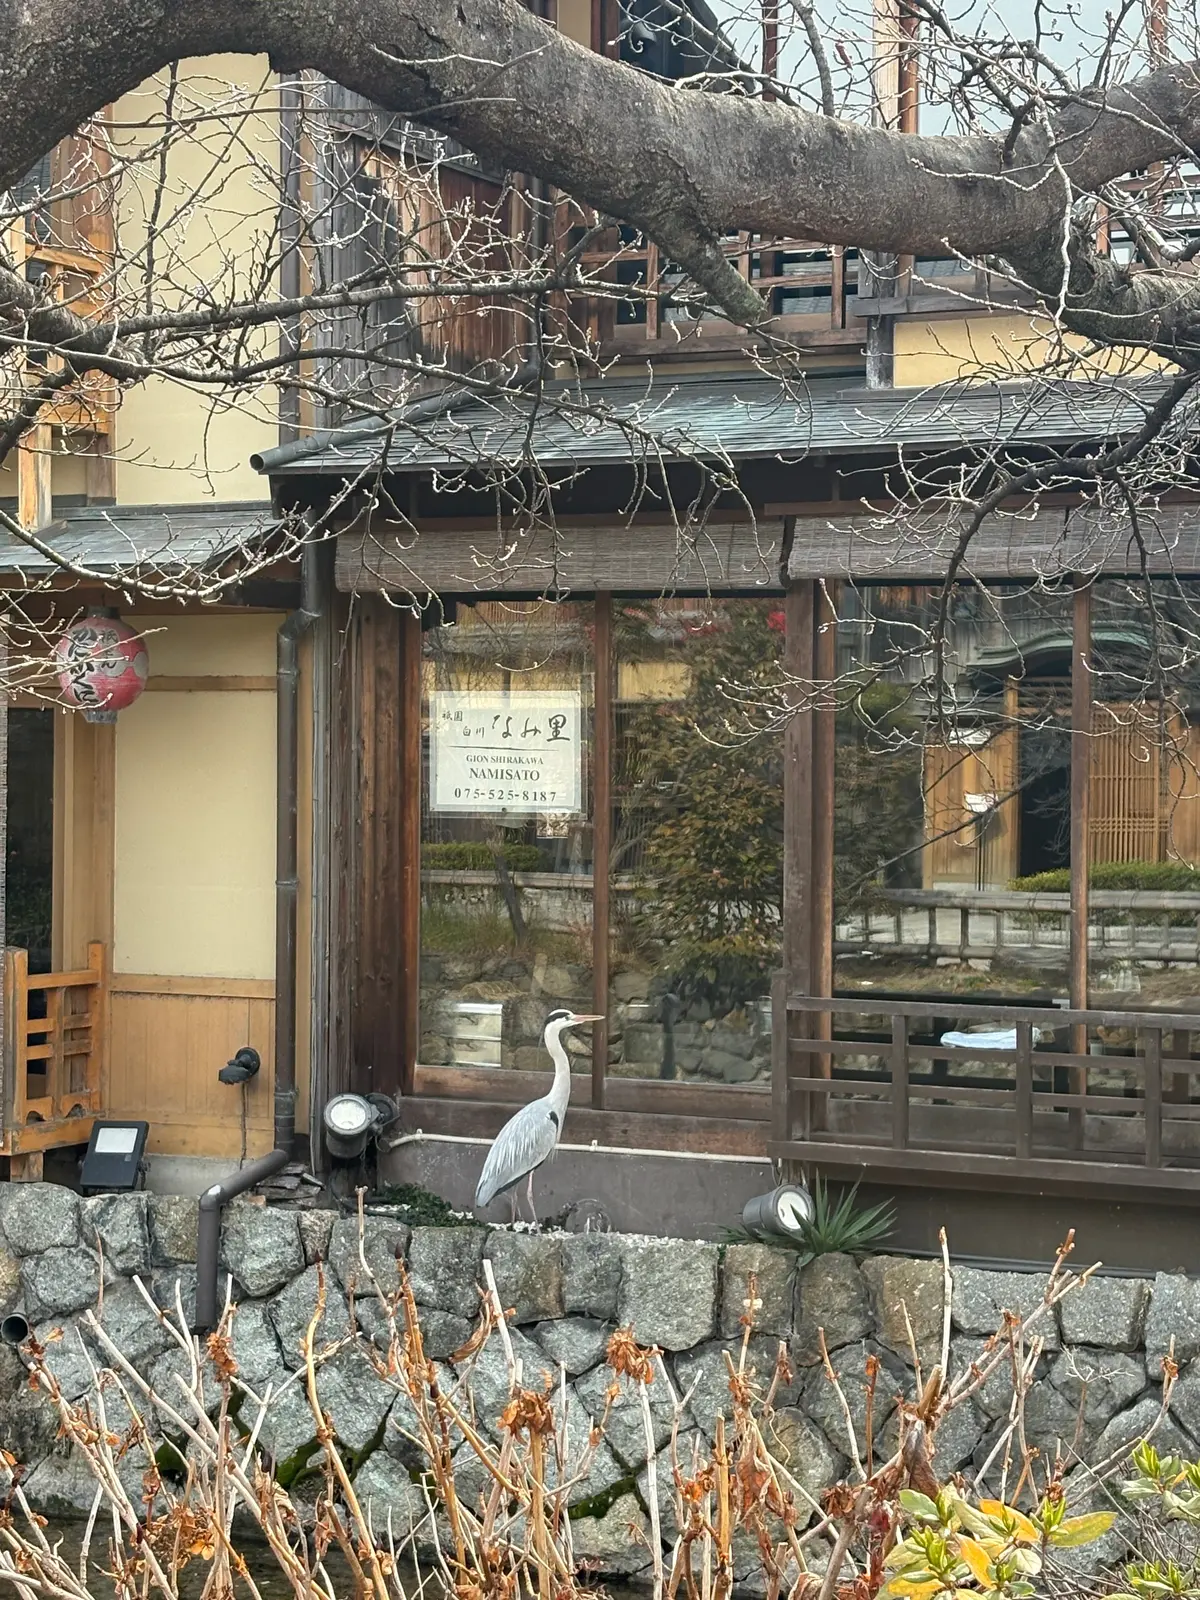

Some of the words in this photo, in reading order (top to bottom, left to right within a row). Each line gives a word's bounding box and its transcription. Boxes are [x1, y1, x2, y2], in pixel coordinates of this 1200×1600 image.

[463, 726, 485, 738] 白川
[492, 714, 571, 742] なみ里
[466, 754, 489, 763] GION
[491, 755, 544, 765] SHIRAKAWA
[469, 768, 540, 781] NAMISATO
[454, 787, 557, 802] 075-525-8187
